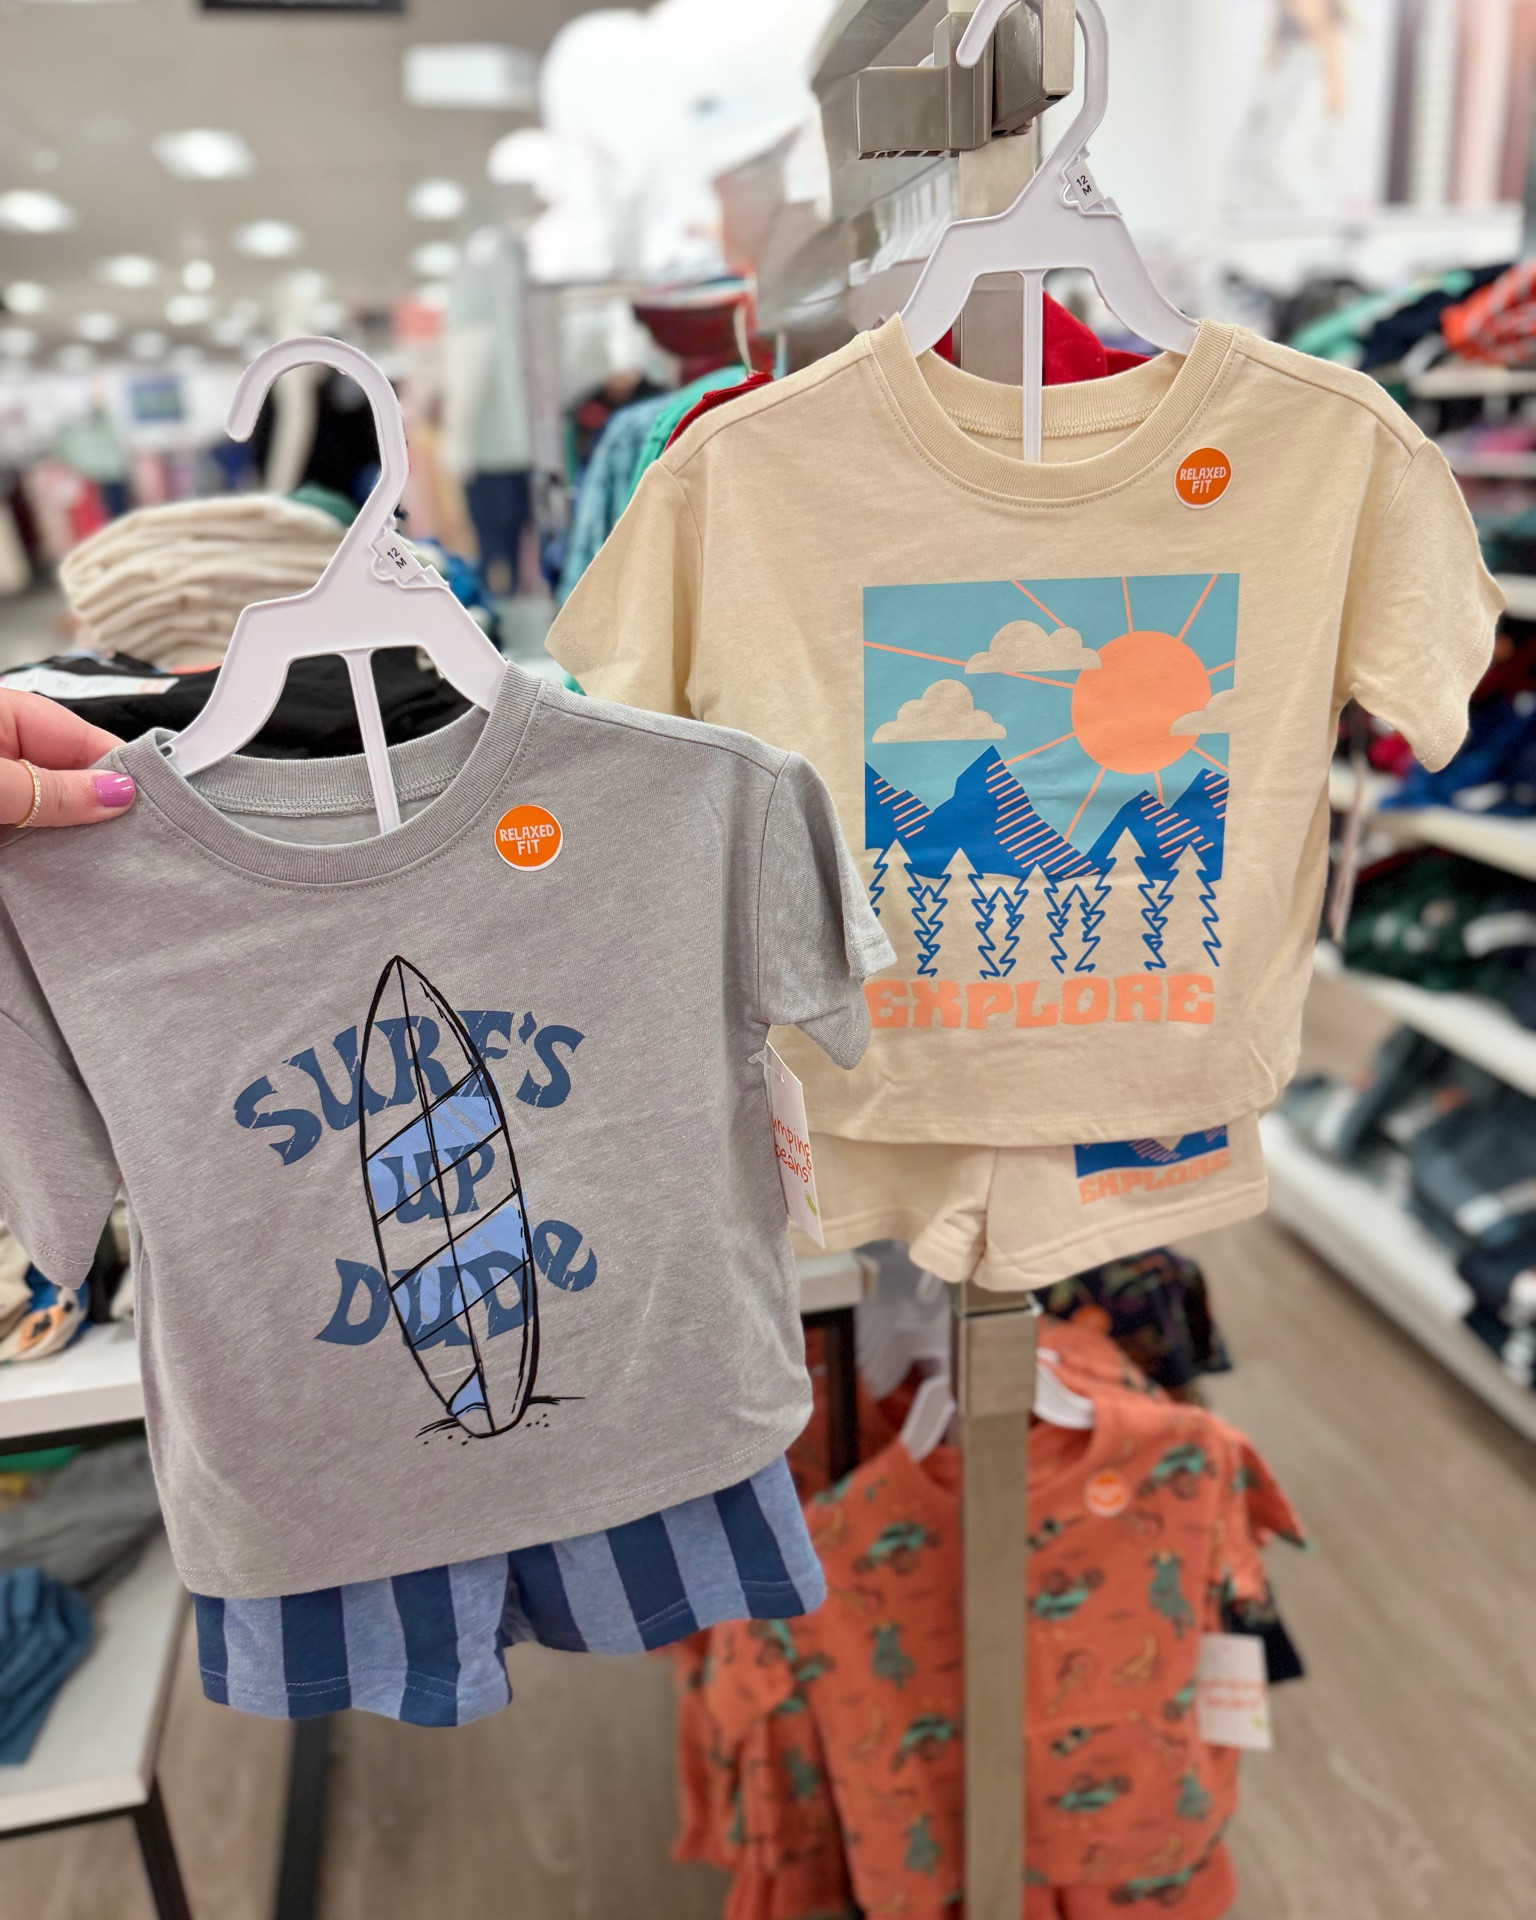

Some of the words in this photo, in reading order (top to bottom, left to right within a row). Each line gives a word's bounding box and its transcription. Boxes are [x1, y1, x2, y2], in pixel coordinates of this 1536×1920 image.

[1076, 175, 1088, 187] 12
[1082, 184, 1093, 196] M
[1180, 466, 1227, 481] RELAXED
[1191, 480, 1212, 494] FIT
[387, 547, 400, 560] 12
[395, 557, 408, 570] M
[499, 824, 555, 842] RELAXED
[517, 838, 540, 855] FIT
[863, 973, 1215, 1030] EXPLORE
[233, 1010, 586, 1165] SURF'S
[771, 1116, 812, 1171] umping
[379, 1142, 496, 1224] UP
[1078, 1150, 1231, 1206] EXPLORE
